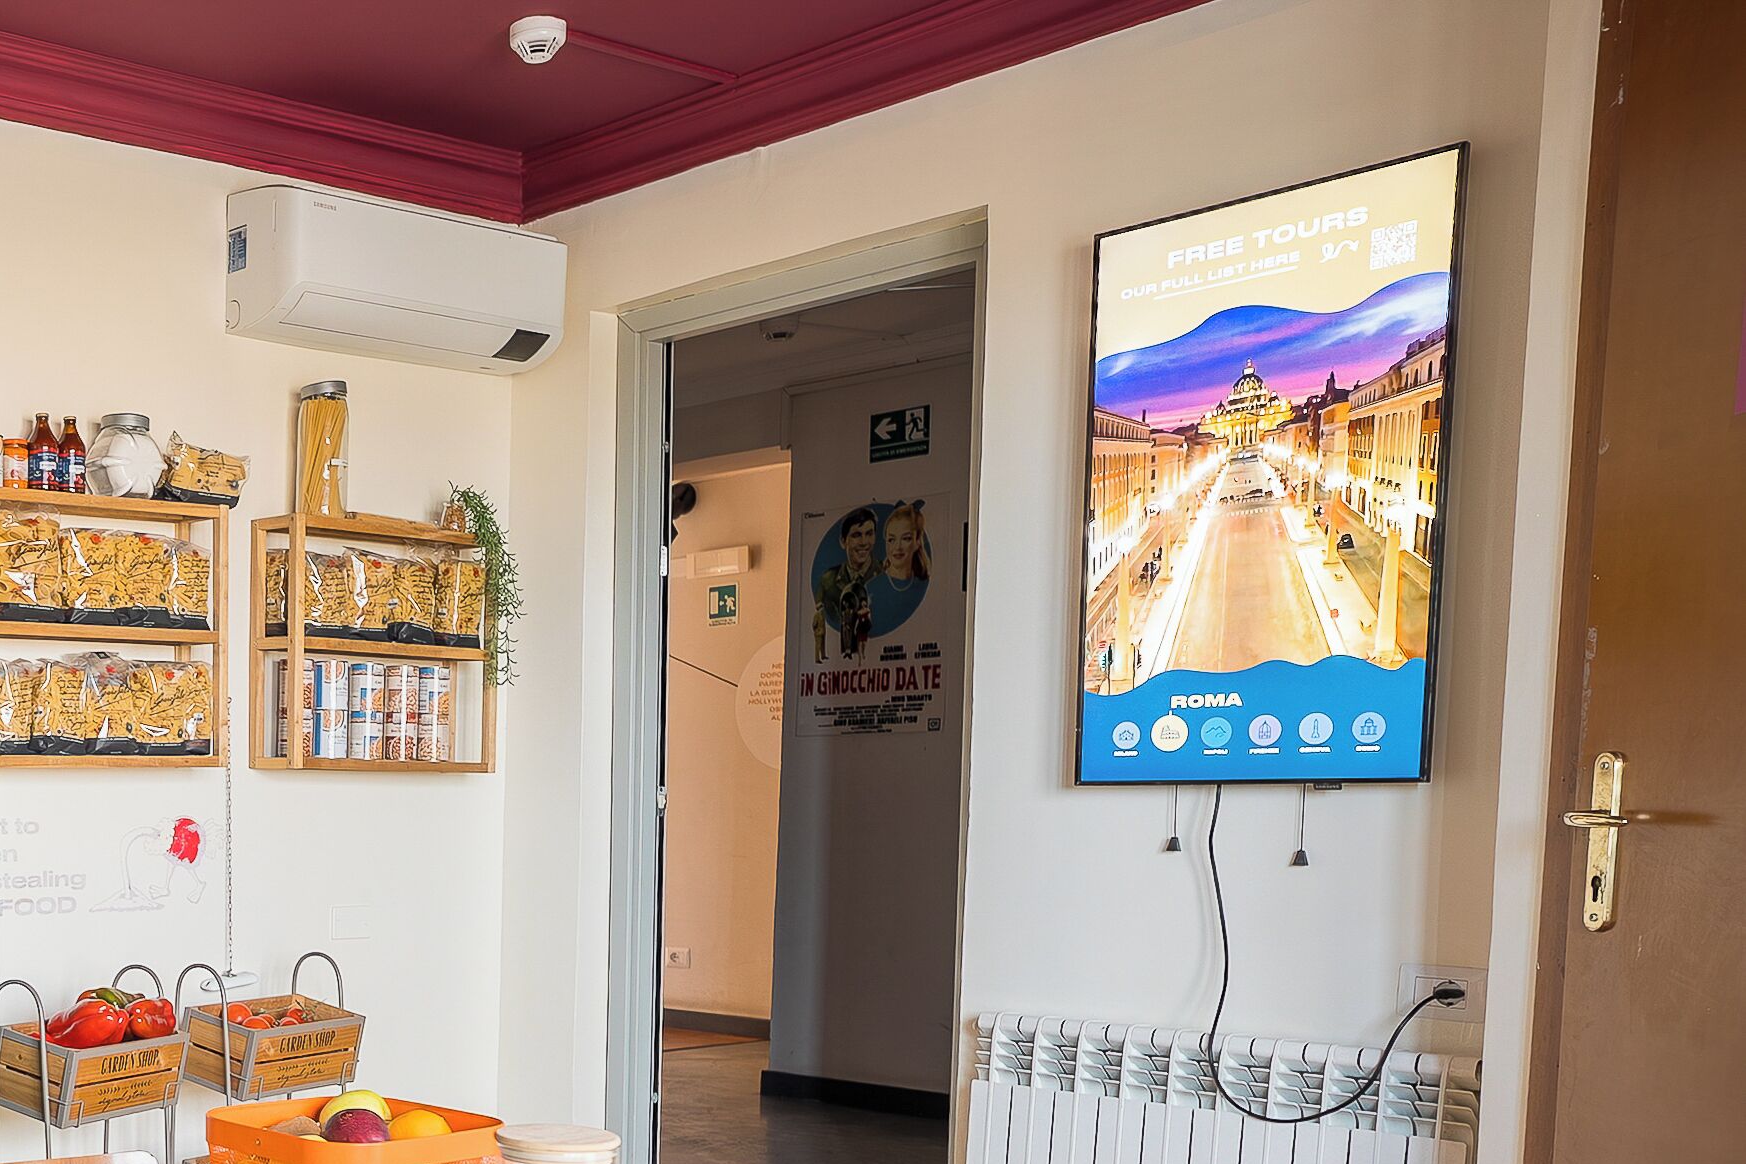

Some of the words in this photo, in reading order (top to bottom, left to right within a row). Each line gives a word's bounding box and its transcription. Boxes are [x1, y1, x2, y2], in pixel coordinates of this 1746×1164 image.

[1167, 235, 1244, 270] FREE
[1251, 206, 1369, 249] TOURS
[1120, 282, 1158, 300] OUR
[1161, 273, 1204, 293] FULL
[1207, 263, 1247, 281] LIST
[1250, 251, 1301, 272] HERE
[895, 665, 919, 691] DA
[922, 664, 942, 690] TE
[1170, 692, 1244, 710] ROMA
[14, 818, 40, 834] to
[279, 1034, 312, 1053] GARDEN
[315, 1030, 336, 1046] SHOP
[101, 1051, 136, 1074] GARDEN
[138, 1049, 159, 1068] SHOP
